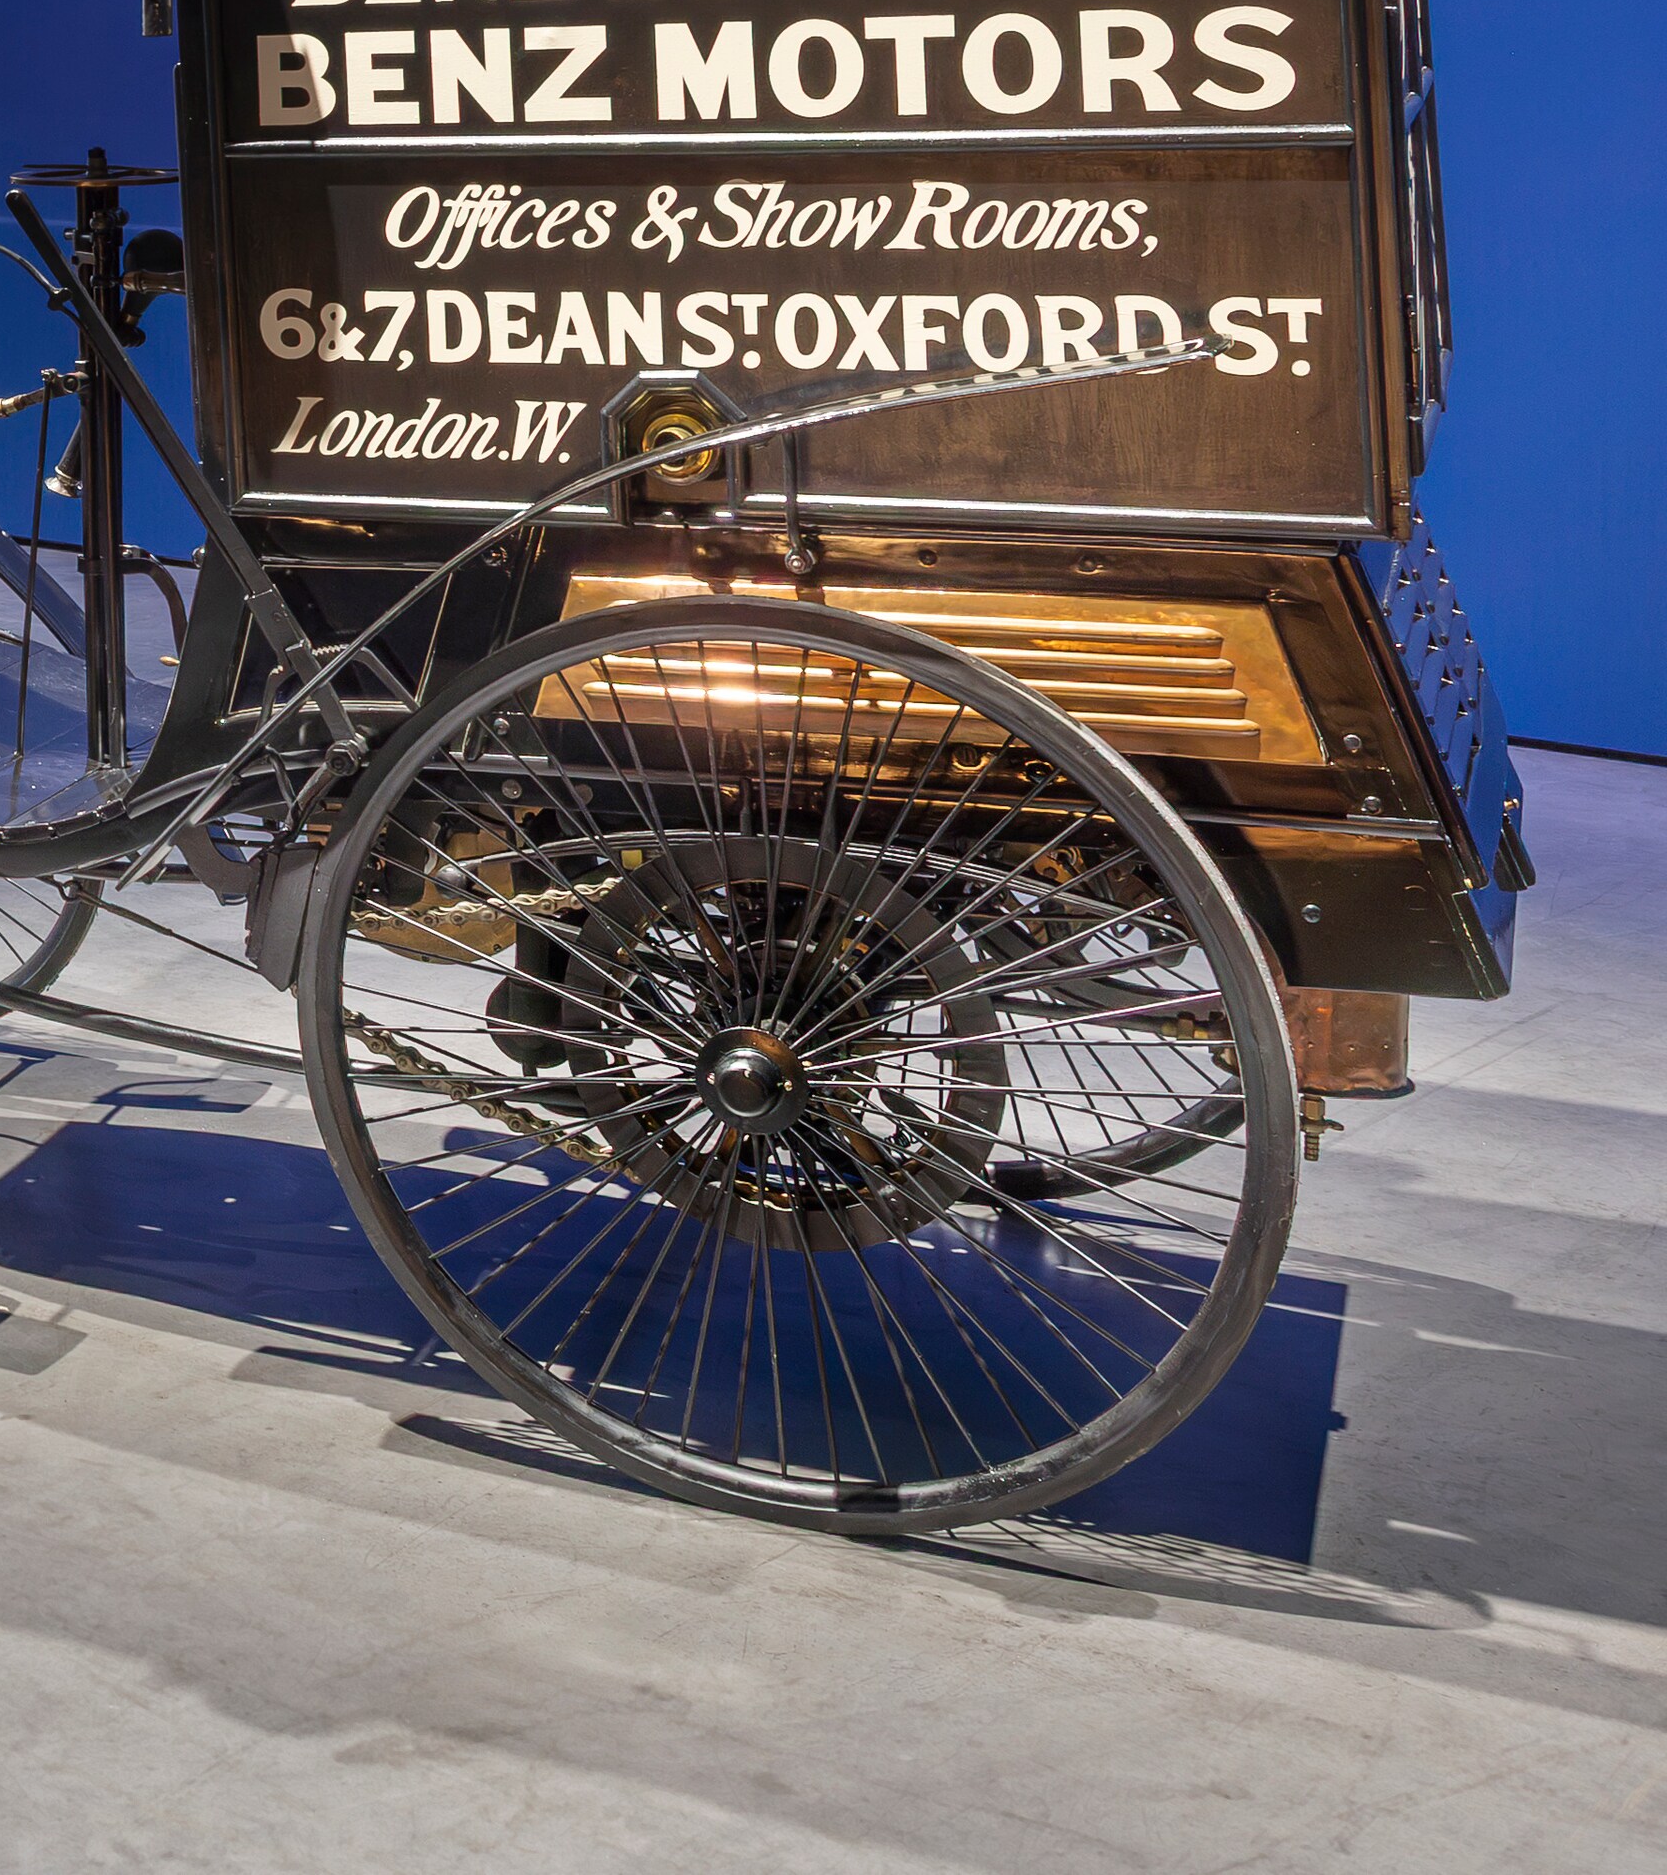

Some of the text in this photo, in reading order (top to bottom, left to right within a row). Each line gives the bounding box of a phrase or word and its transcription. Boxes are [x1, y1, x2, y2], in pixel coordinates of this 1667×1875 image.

[255, 5, 1297, 127] BENZ MOTORS
[383, 178, 1160, 270] Offices & Show Rooms,
[425, 289, 665, 366] DEAN
[773, 292, 1183, 375] OXFORD
